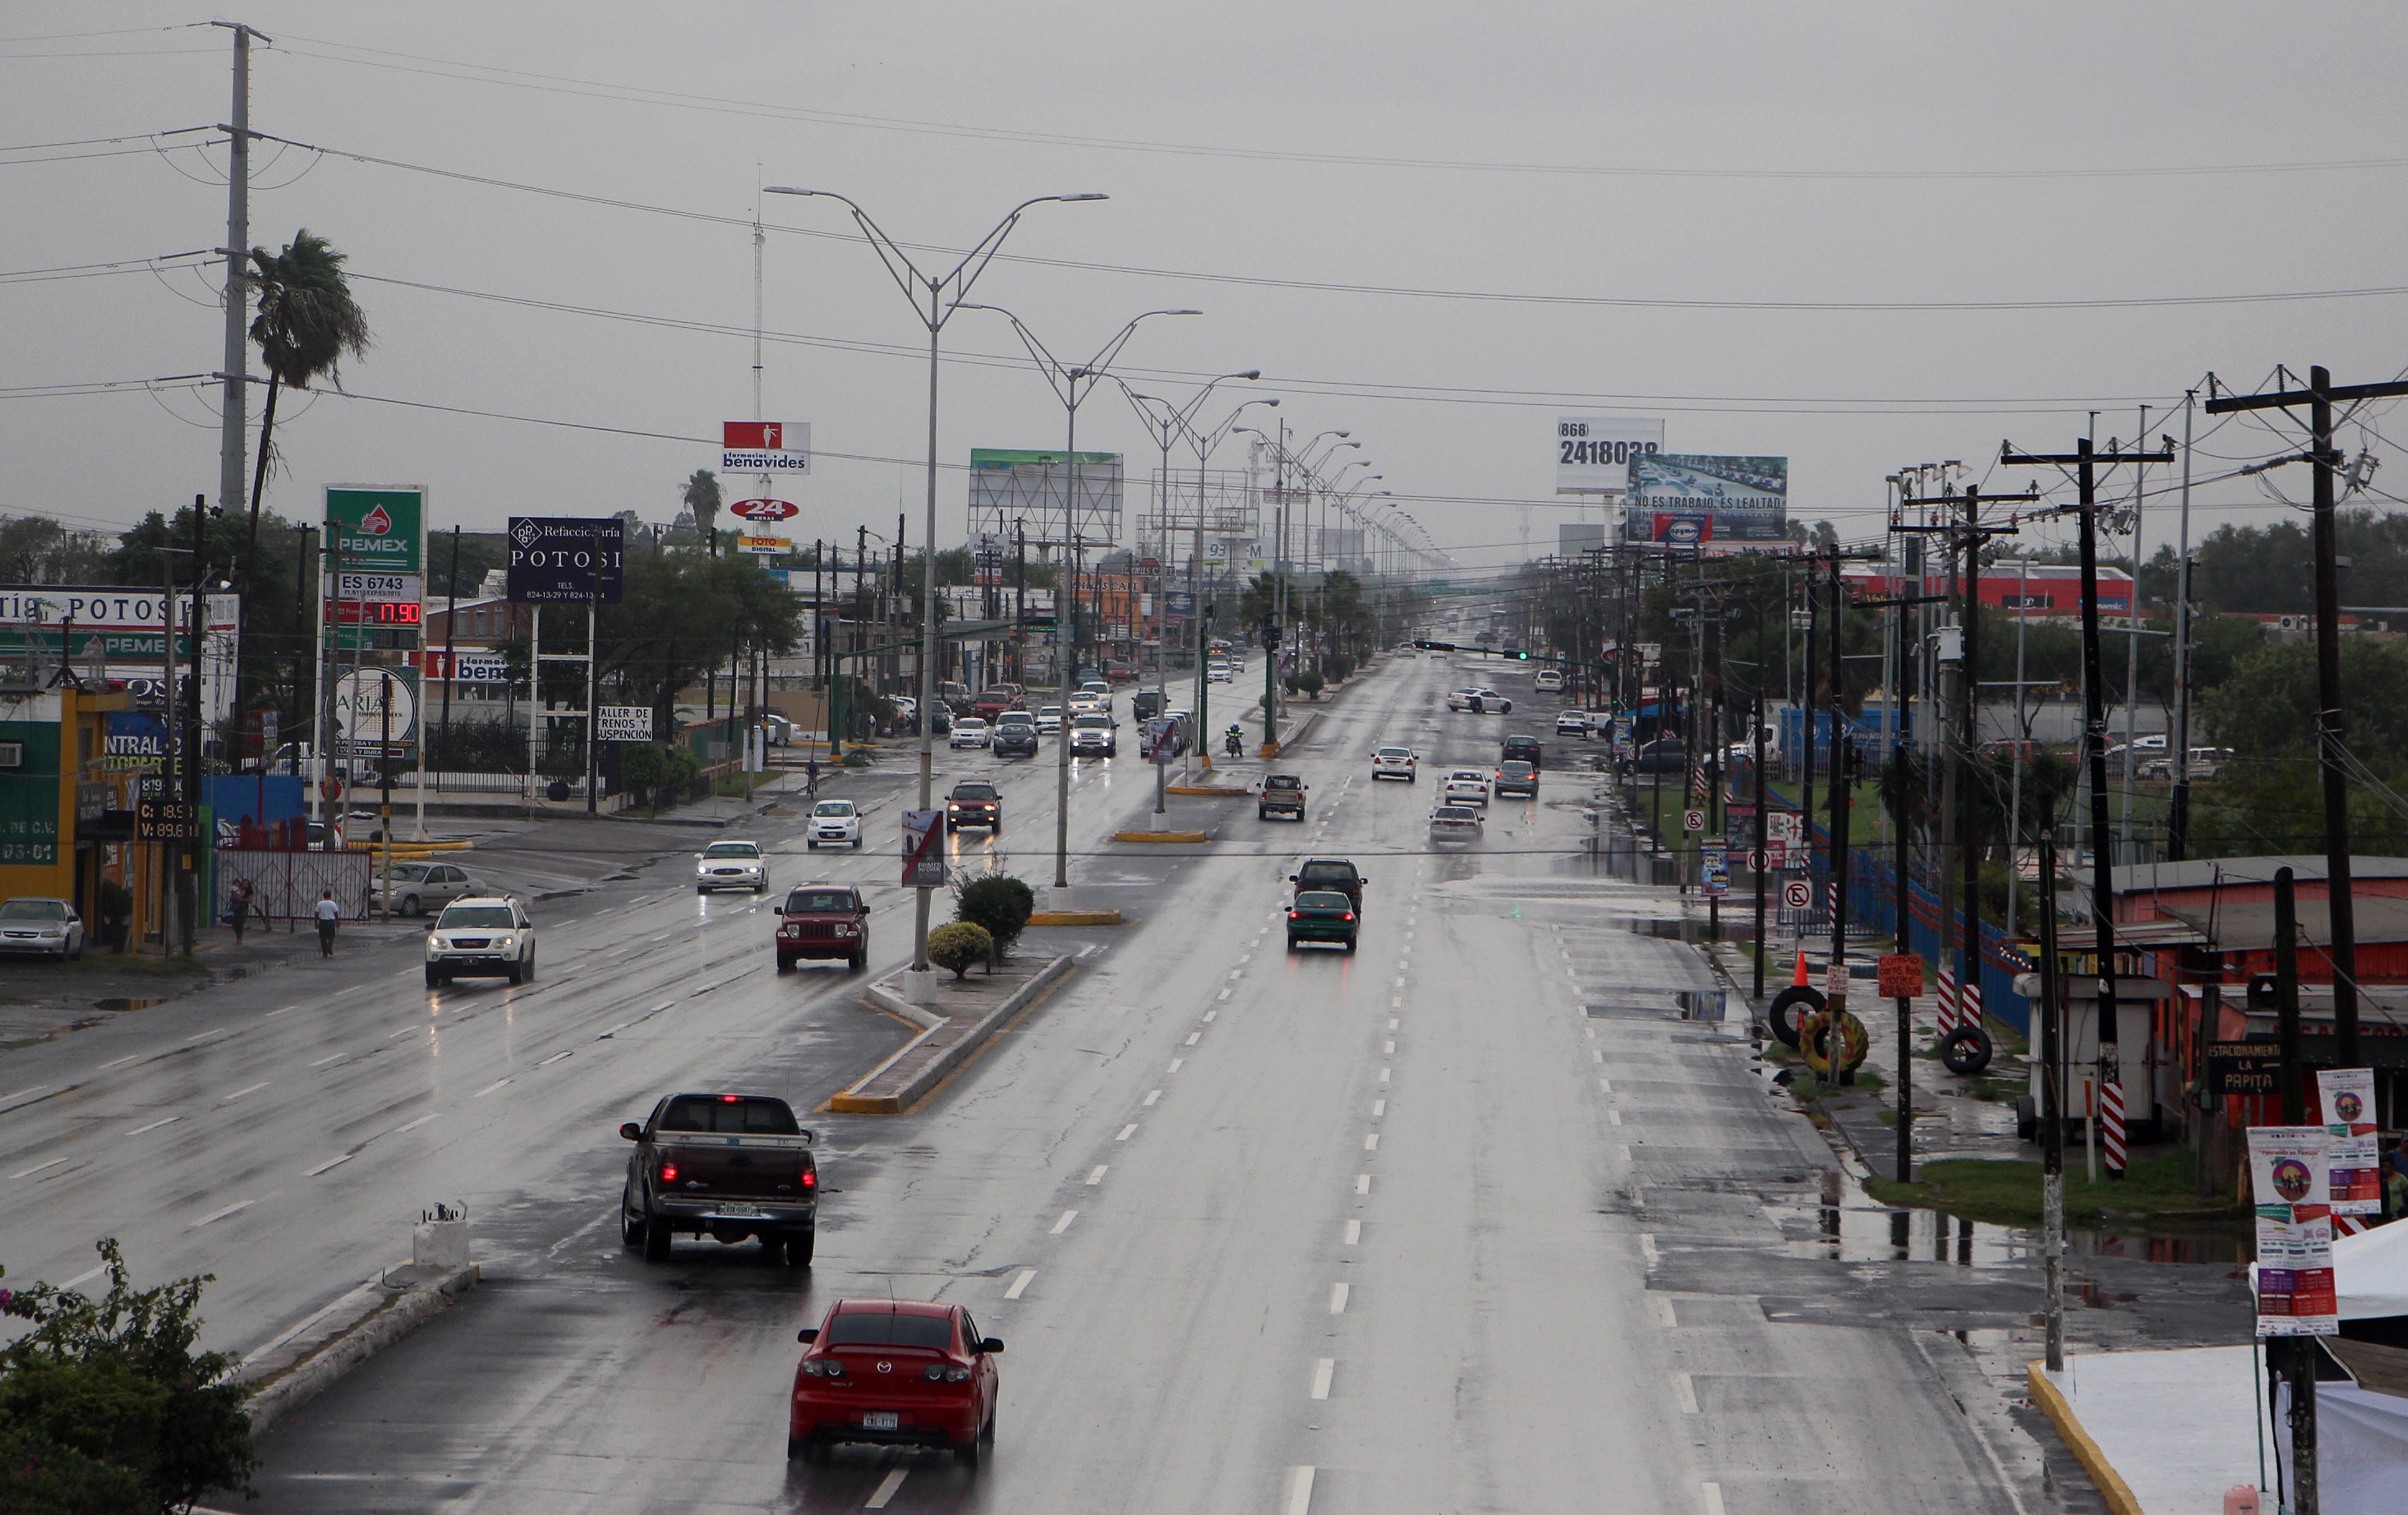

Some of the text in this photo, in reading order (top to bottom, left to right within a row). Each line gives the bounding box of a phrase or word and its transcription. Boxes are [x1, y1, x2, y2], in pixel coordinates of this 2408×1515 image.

[1559, 423, 1589, 437] (868)
[724, 454, 805, 468] benavides
[745, 500, 785, 514] 24
[1636, 496, 1648, 507] NO
[1653, 496, 1664, 507] ES
[1721, 498, 1733, 509] ES
[1737, 498, 1780, 509] LEALTAD
[339, 538, 407, 551] PEMEX
[511, 550, 621, 568] POTOSI
[343, 576, 403, 589] ES 6743
[380, 604, 420, 623] 17.90
[106, 638, 182, 654] PEMEX
[636, 709, 647, 718] DE
[642, 720, 647, 729] Y
[2239, 1060, 2252, 1071] LA
[2225, 1074, 2273, 1088] PAPITA
